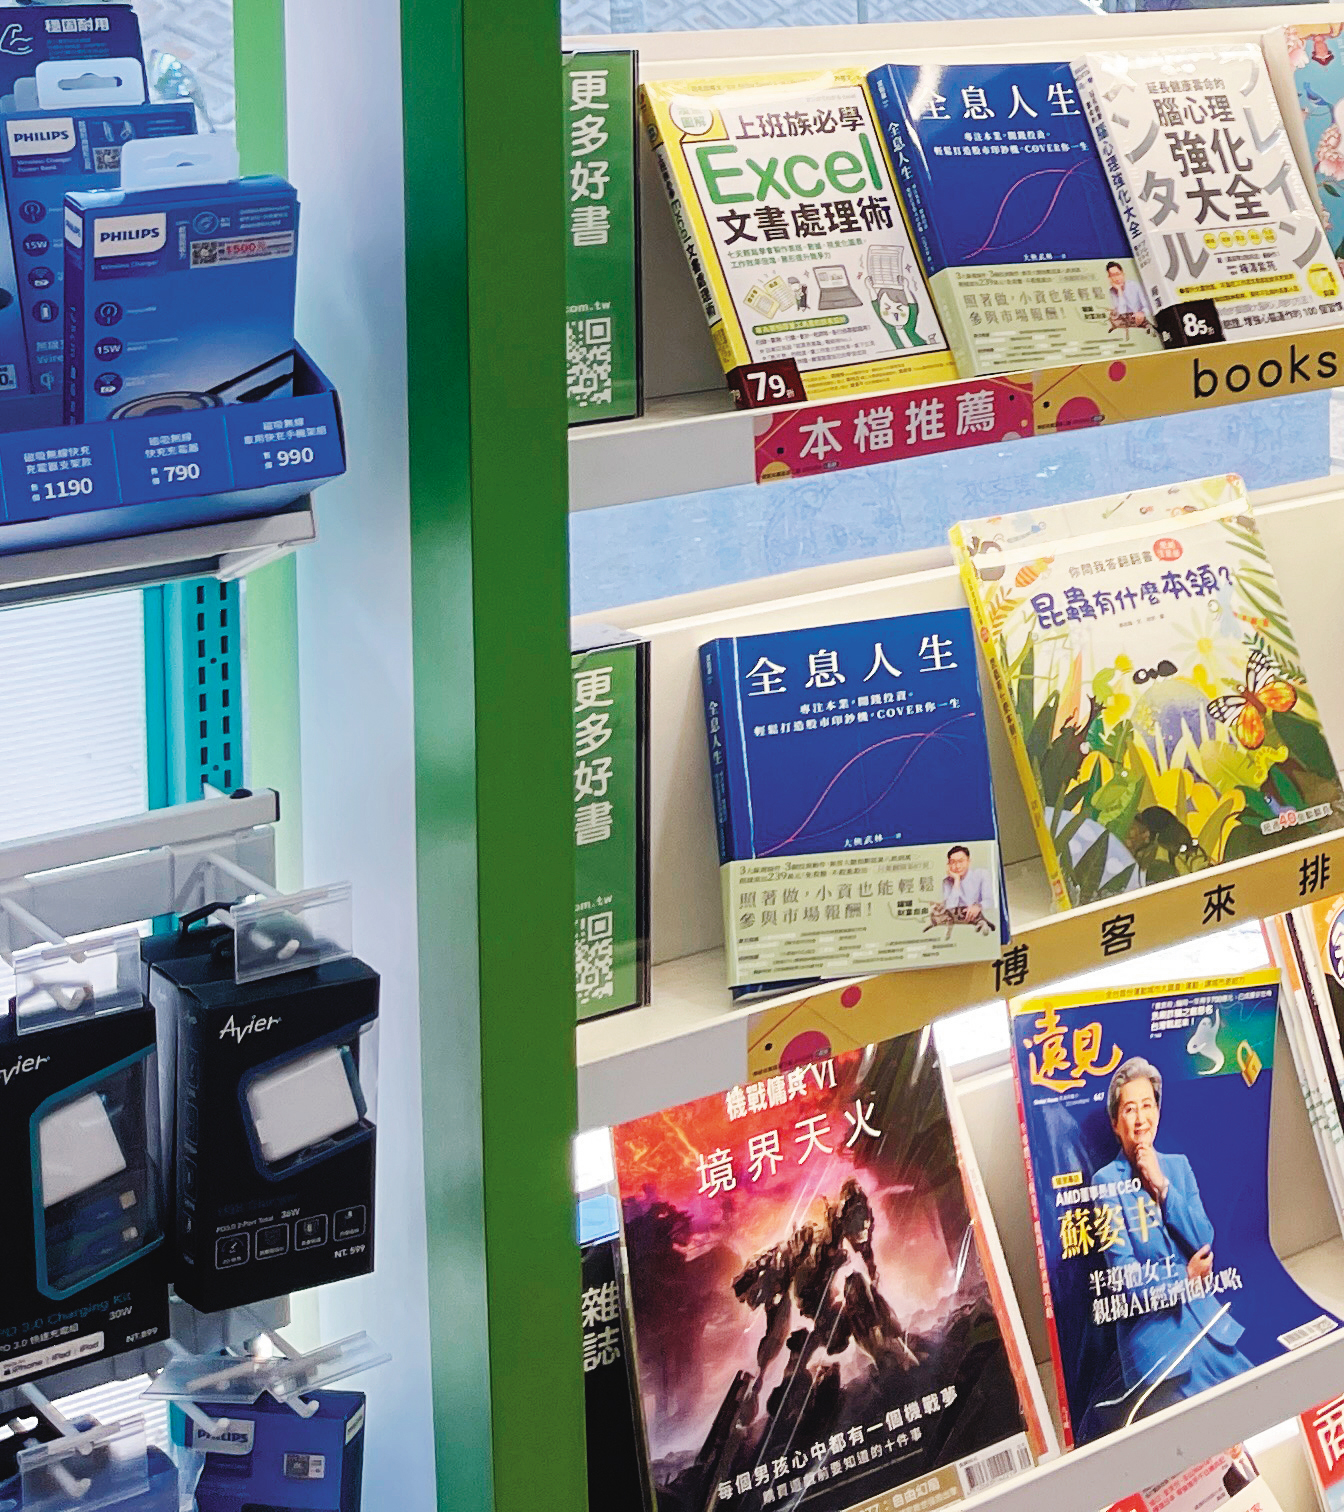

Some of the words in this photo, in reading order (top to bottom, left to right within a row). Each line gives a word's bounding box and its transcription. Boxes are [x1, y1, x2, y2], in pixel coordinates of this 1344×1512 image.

[736, 106, 865, 140] 上班族必學
[921, 83, 1081, 120] 全息人生
[1153, 95, 1235, 127] 腦心理
[13, 129, 70, 144] PHILIPS
[568, 70, 611, 247] 更多好書
[888, 122, 914, 181] 全息人生
[1165, 128, 1253, 177] 強化
[696, 132, 884, 205] Excel
[716, 195, 894, 246] 文書處理術
[1187, 174, 1269, 224] 大全
[100, 227, 160, 243] PHILIPS
[97, 343, 122, 355] 15W
[799, 389, 996, 460] 本檔推薦
[164, 463, 201, 483] 790
[277, 447, 314, 467] 990
[44, 477, 93, 501] 1190
[746, 634, 958, 696] 全息人生
[573, 666, 613, 846] 更多好書
[708, 700, 723, 766] 全息人生
[219, 1013, 283, 1044] Avier
[1023, 1003, 1123, 1093] 遠見
[0, 1054, 50, 1086] vier
[696, 1099, 882, 1199] 境界天火
[581, 1280, 621, 1372] 雜誌
[717, 1384, 959, 1502] 每個男孩心中都有一個機戰夢
